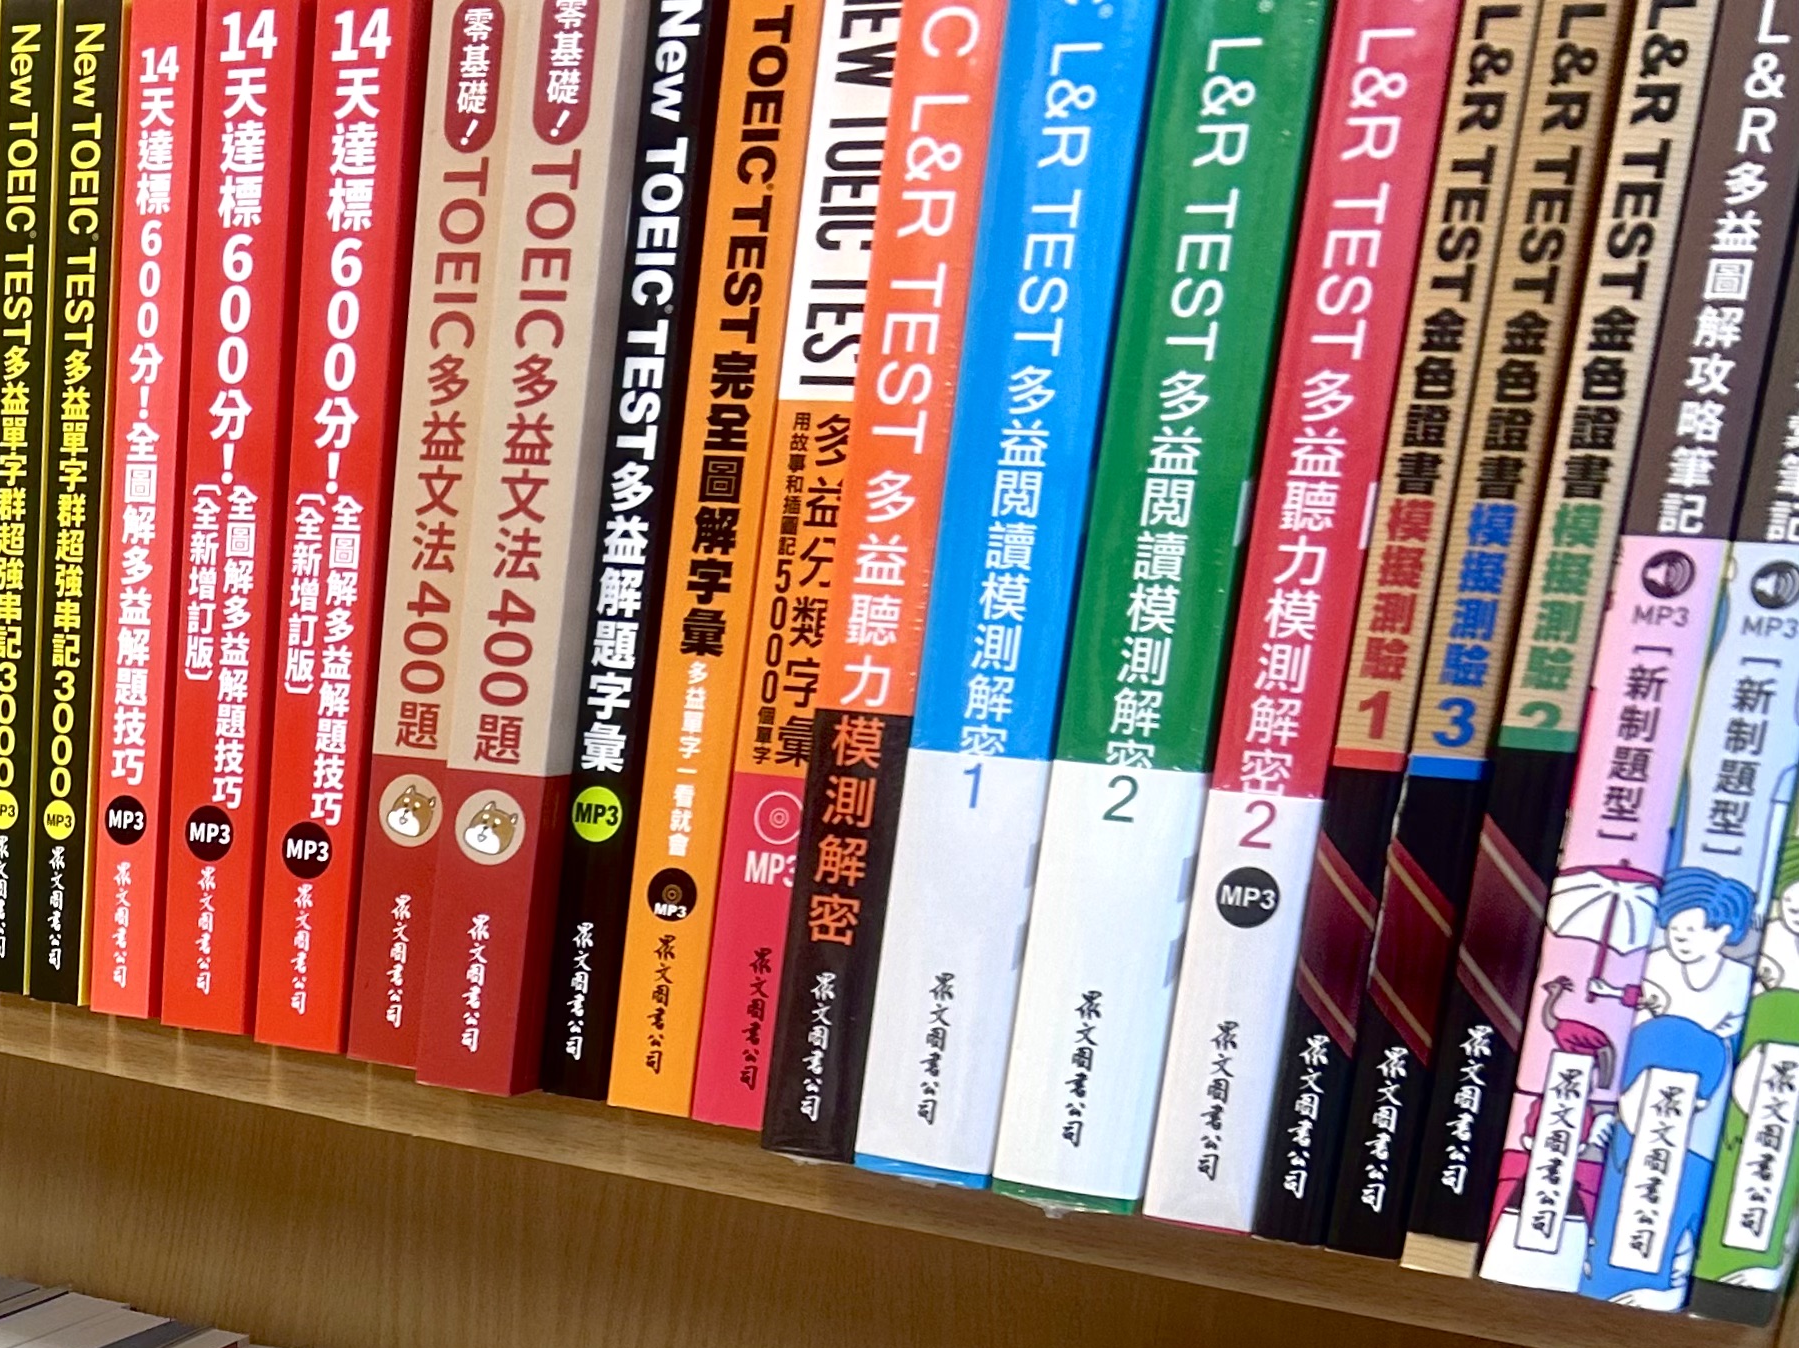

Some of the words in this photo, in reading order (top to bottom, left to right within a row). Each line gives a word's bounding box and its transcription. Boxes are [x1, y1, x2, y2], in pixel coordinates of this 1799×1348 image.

[649, 2, 700, 123] New
[738, 6, 792, 187] TOEIC
[1037, 42, 1103, 168] L&R
[1192, 36, 1263, 167] L&R
[1341, 27, 1415, 162] L&R
[1457, 3, 1522, 132] L&R
[631, 137, 687, 307] TOEIC
[897, 92, 969, 238] L&R
[1431, 144, 1498, 303] TEST
[428, 158, 489, 350] TOEIC
[719, 196, 769, 345] TEST
[1013, 189, 1082, 357] TEST
[1165, 188, 1239, 361] TEST
[1310, 182, 1390, 361] TEST
[614, 320, 669, 460] TEST
[872, 263, 947, 454] TEST
[1656, 161, 1769, 535] 多益圖解攻略筆記
[680, 350, 757, 659] 完全圖解字彙
[580, 461, 654, 773] 多益解題字彙
[1239, 369, 1354, 798] 多益聽力模測解密
[1631, 605, 1688, 627] MP3
[667, 661, 709, 857] 多益單字一看就會
[808, 470, 913, 947] 多益聽力模測解密
[108, 808, 144, 831] MP3
[189, 822, 231, 845] MP3
[962, 763, 982, 809] 1
[1102, 774, 1139, 823] 2
[1238, 799, 1278, 850] 2
[1220, 884, 1275, 911] MP3
